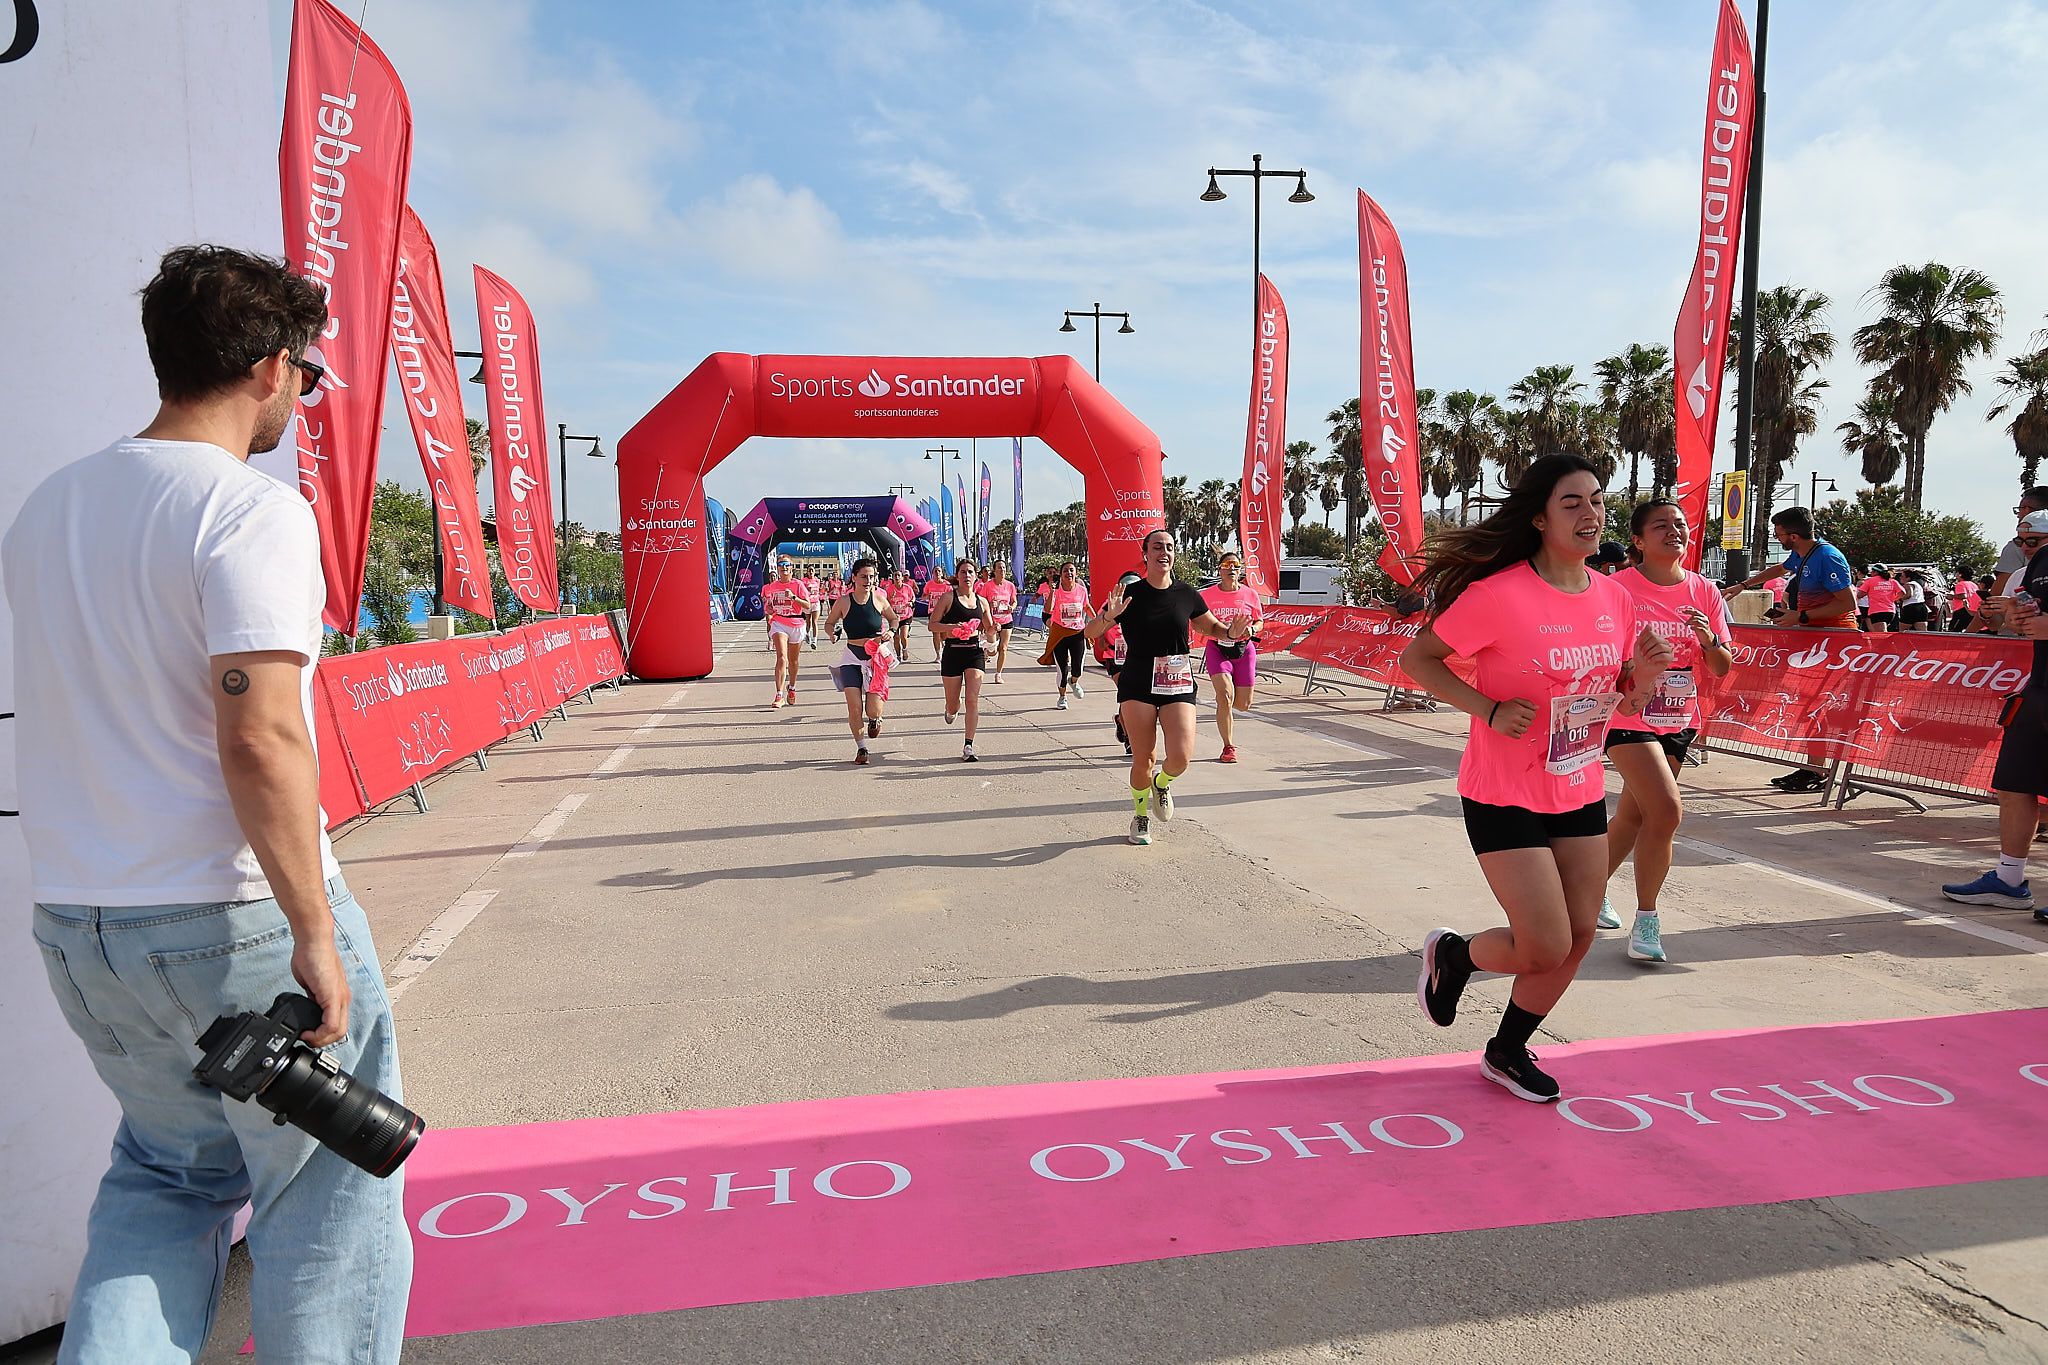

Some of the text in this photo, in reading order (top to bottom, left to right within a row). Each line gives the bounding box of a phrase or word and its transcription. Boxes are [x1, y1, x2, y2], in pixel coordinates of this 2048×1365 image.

[770, 372, 1025, 403] Sports Santander
[854, 408, 939, 419] sportssantander.es
[1116, 489, 1151, 502] Sports
[640, 498, 680, 512] Sports
[1114, 508, 1162, 519] Santander
[638, 518, 697, 530] Santander
[1634, 604, 1655, 612] YSHO
[1336, 614, 1375, 634] Sports
[1539, 624, 1573, 634] OYSHO
[460, 642, 526, 687] Sports Santander
[1548, 643, 1622, 671] CARRERA
[1731, 645, 1790, 668] orts
[342, 659, 450, 718] Sports Santander
[1665, 697, 1686, 707] 016
[1568, 725, 1589, 742] 016
[1556, 1073, 1955, 1133] OYSHO
[1029, 1113, 1465, 1182] OYSHO
[418, 1160, 912, 1239] OYSHO
